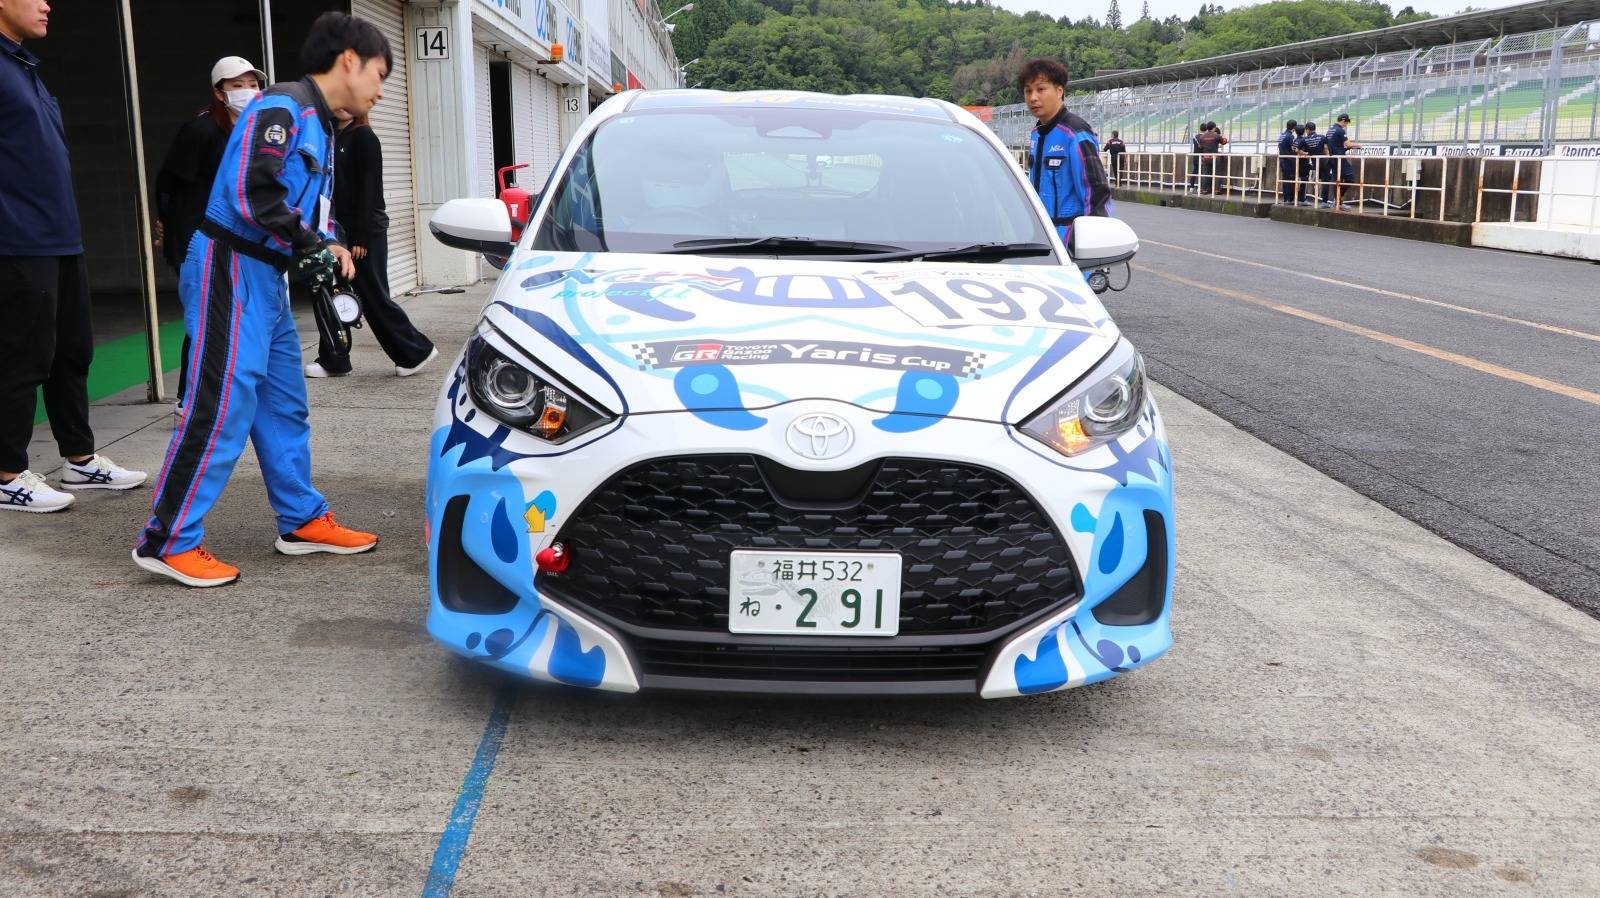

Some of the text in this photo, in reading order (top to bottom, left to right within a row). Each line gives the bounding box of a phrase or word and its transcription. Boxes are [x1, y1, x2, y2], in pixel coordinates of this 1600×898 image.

[419, 30, 446, 57] 14
[566, 98, 579, 112] 13
[890, 278, 1100, 329] 192
[672, 348, 719, 361] GR
[781, 343, 952, 371] Yaris Cup
